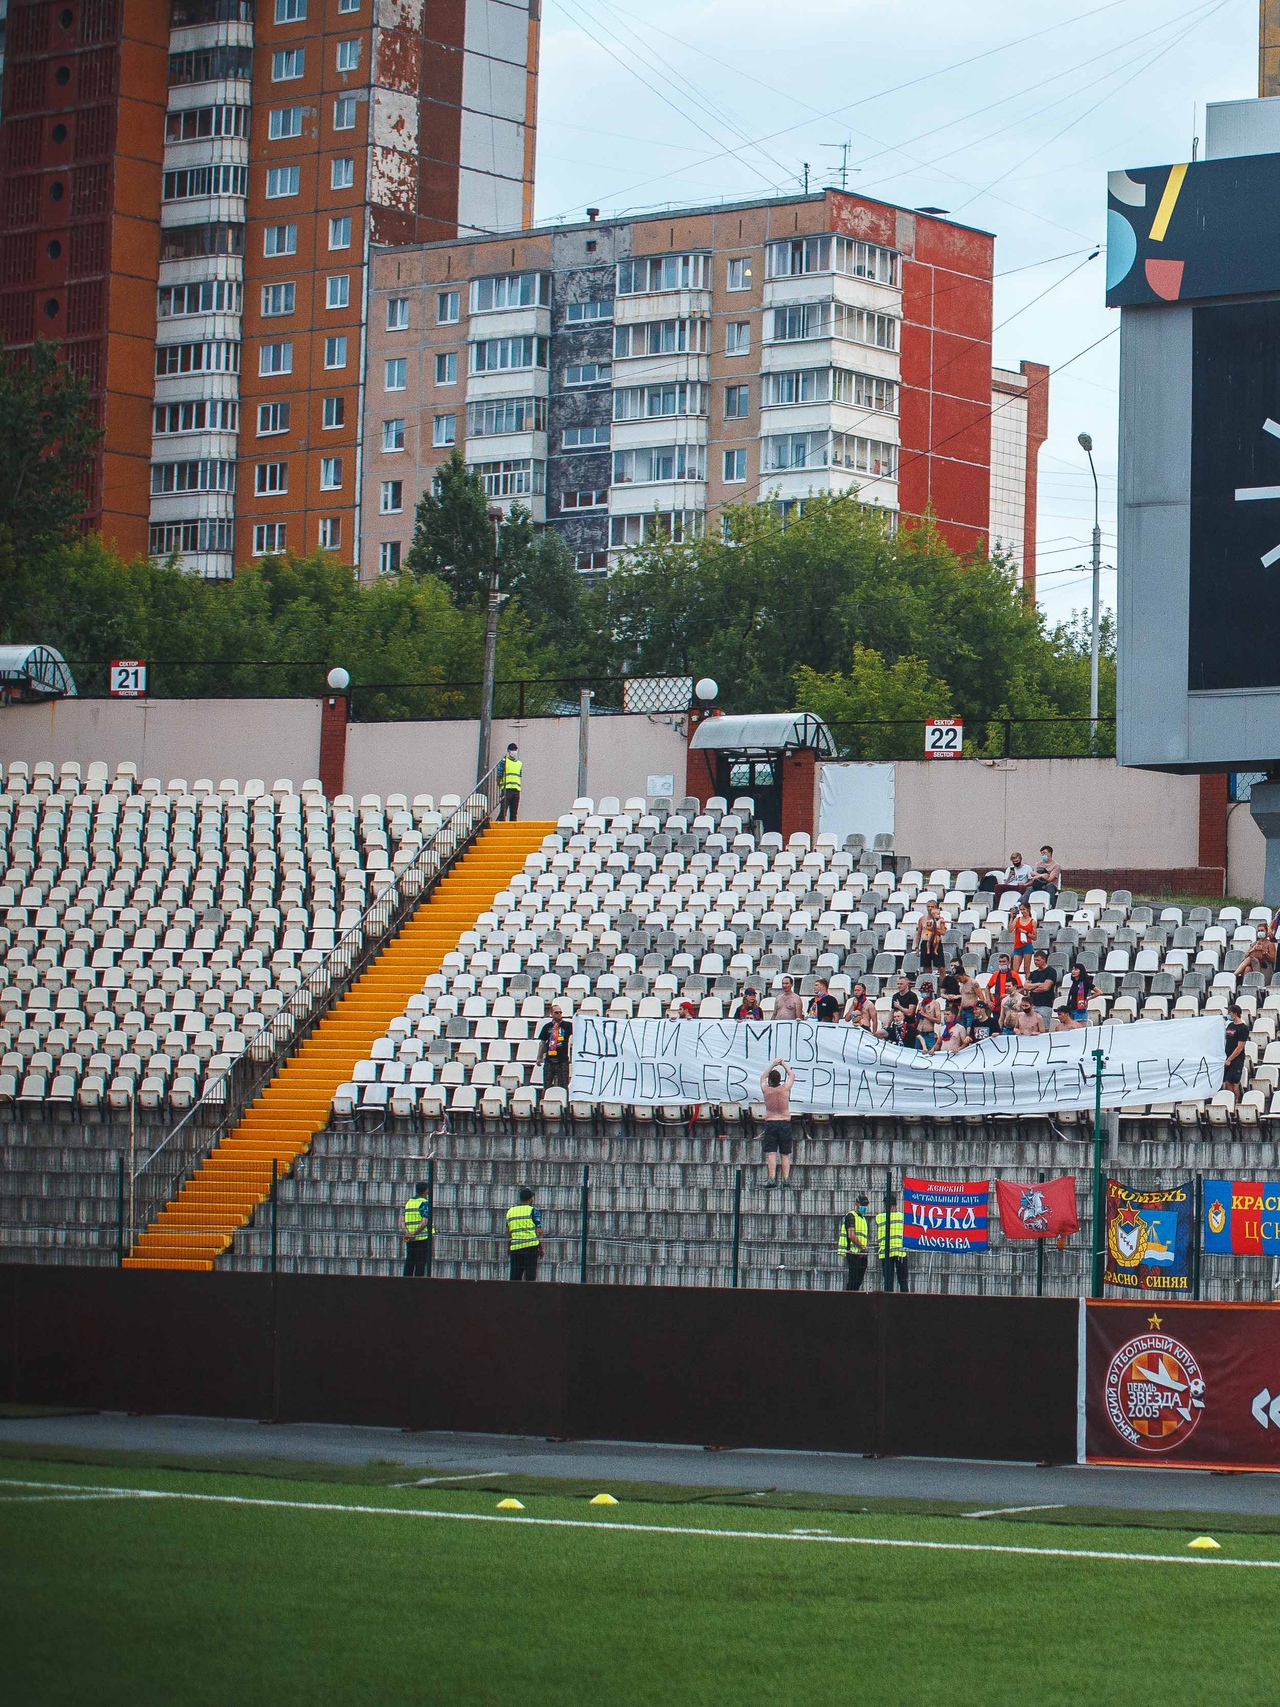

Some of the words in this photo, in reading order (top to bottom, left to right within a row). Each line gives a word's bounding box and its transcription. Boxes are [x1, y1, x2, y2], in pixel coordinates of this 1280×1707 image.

[117, 668, 139, 689] 21
[930, 727, 958, 749] 22
[933, 1070, 1016, 1109] ВОН
[1036, 1068, 1083, 1103] ИЗ
[926, 1184, 965, 1193] ЖЕНСКИЙ
[1109, 1183, 1188, 1203] ТЮМЕНЬ
[910, 1203, 978, 1233] ЦСКА
[918, 1234, 971, 1250] МОСКВА
[1146, 1275, 1188, 1289] СИНЯЯ
[1109, 1337, 1174, 1385] ФУТБОЛЬНЫЙ
[1173, 1346, 1197, 1375] КЛУБ
[1126, 1382, 1157, 1392] ПЕРМЬ
[1127, 1390, 1183, 1409] ЗВЕЗДА
[1107, 1386, 1141, 1444] ЖЕНСКИЙ
[1127, 1405, 1160, 1418] 2005
